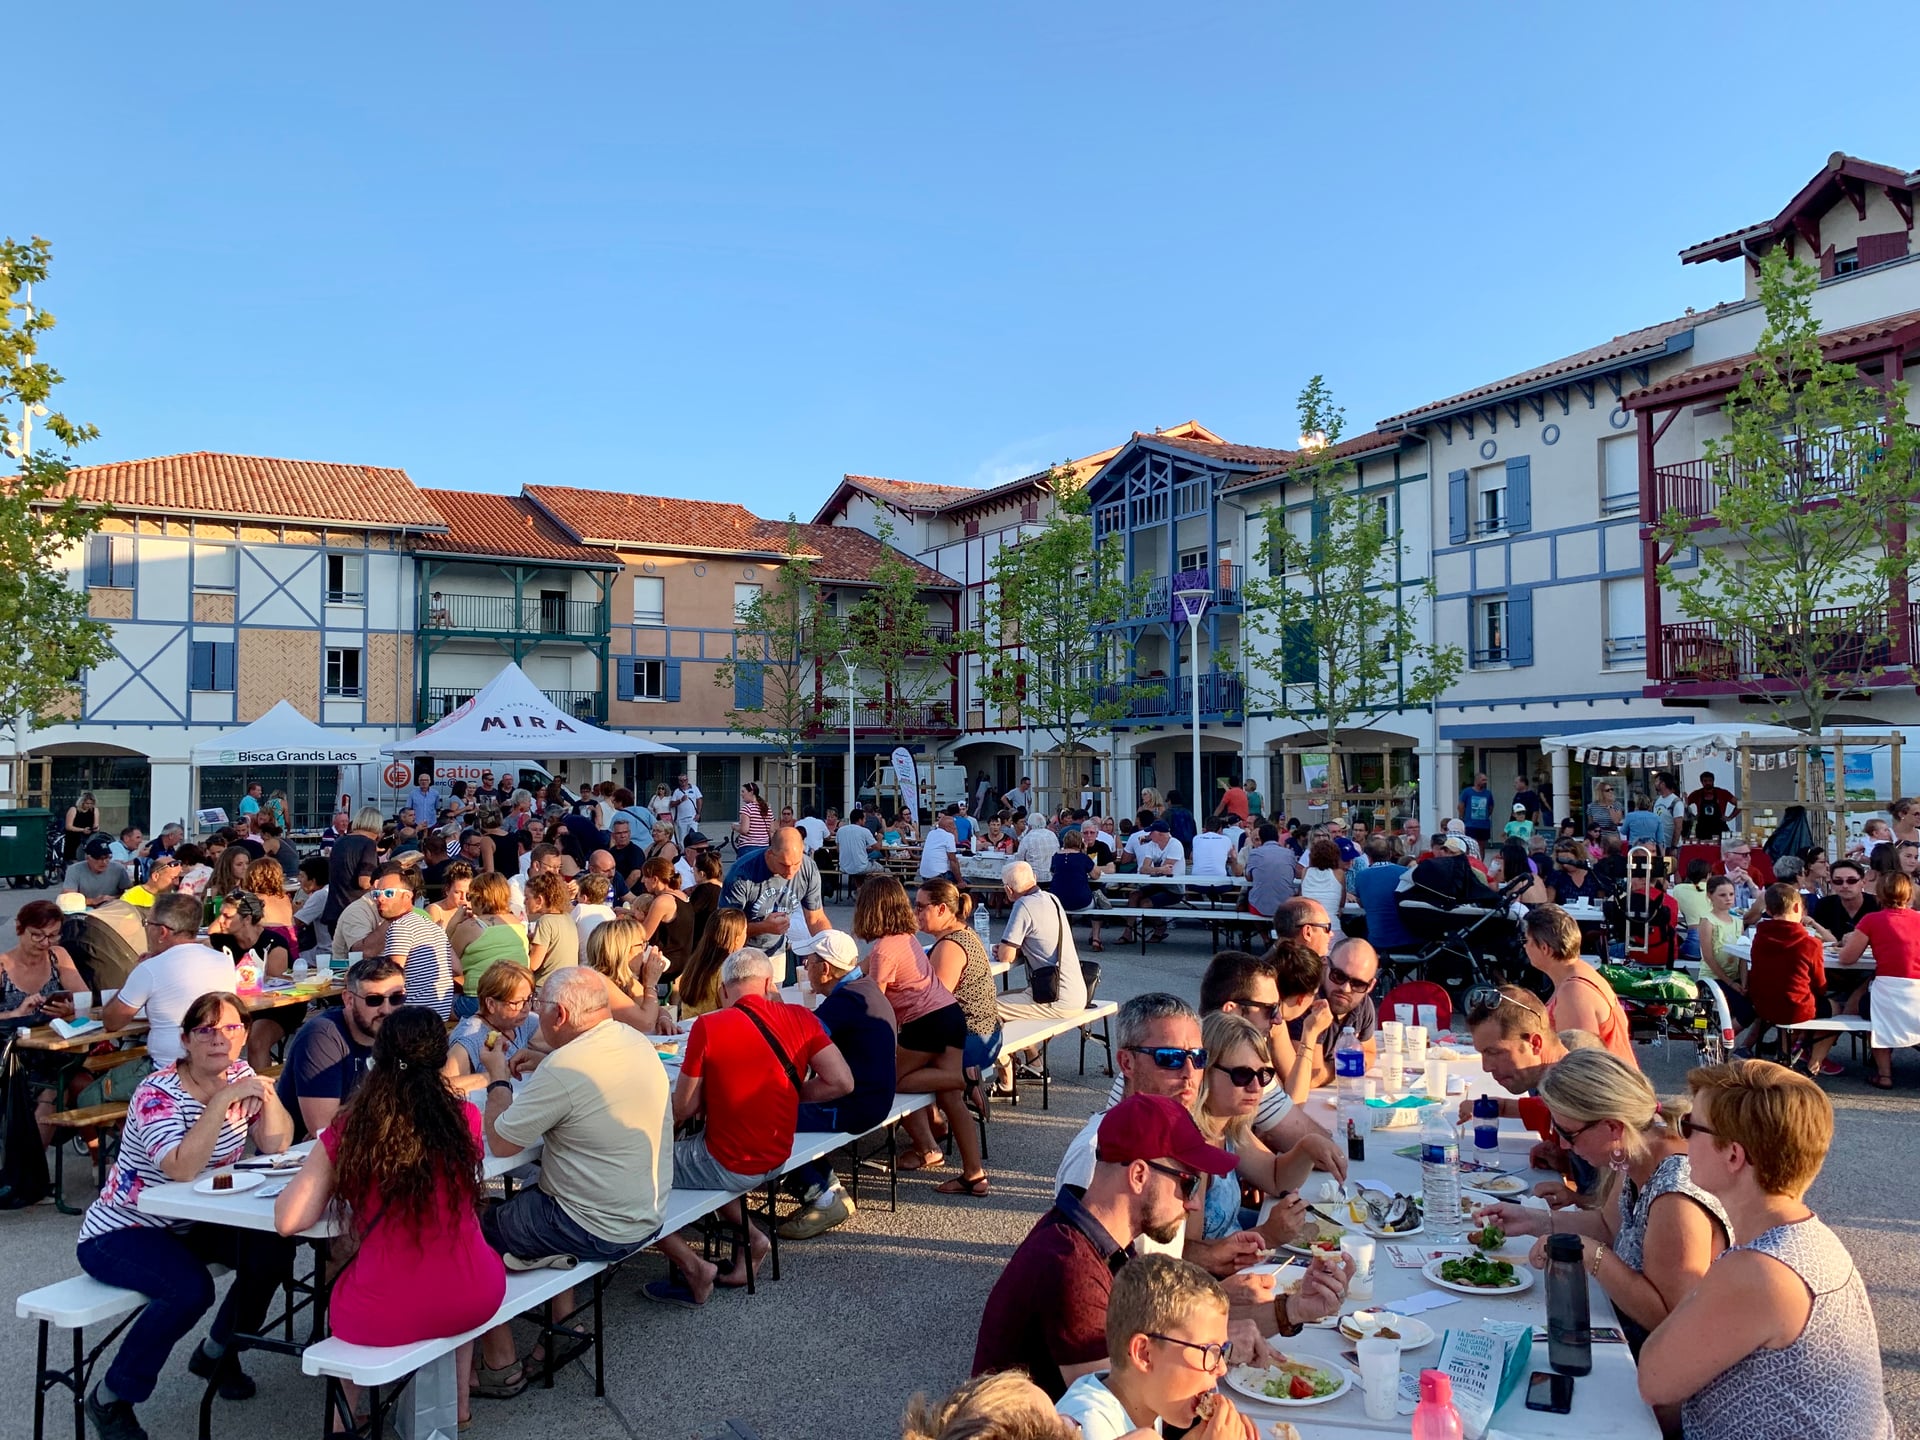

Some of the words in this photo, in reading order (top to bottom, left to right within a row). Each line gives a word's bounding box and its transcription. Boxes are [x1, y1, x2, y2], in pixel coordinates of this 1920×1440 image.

[481, 715, 577, 734] MIRA
[238, 750, 274, 762] Bisca
[276, 750, 325, 762] Grands
[328, 750, 357, 761] Lacs
[1448, 1363, 1488, 1381] MOULIN
